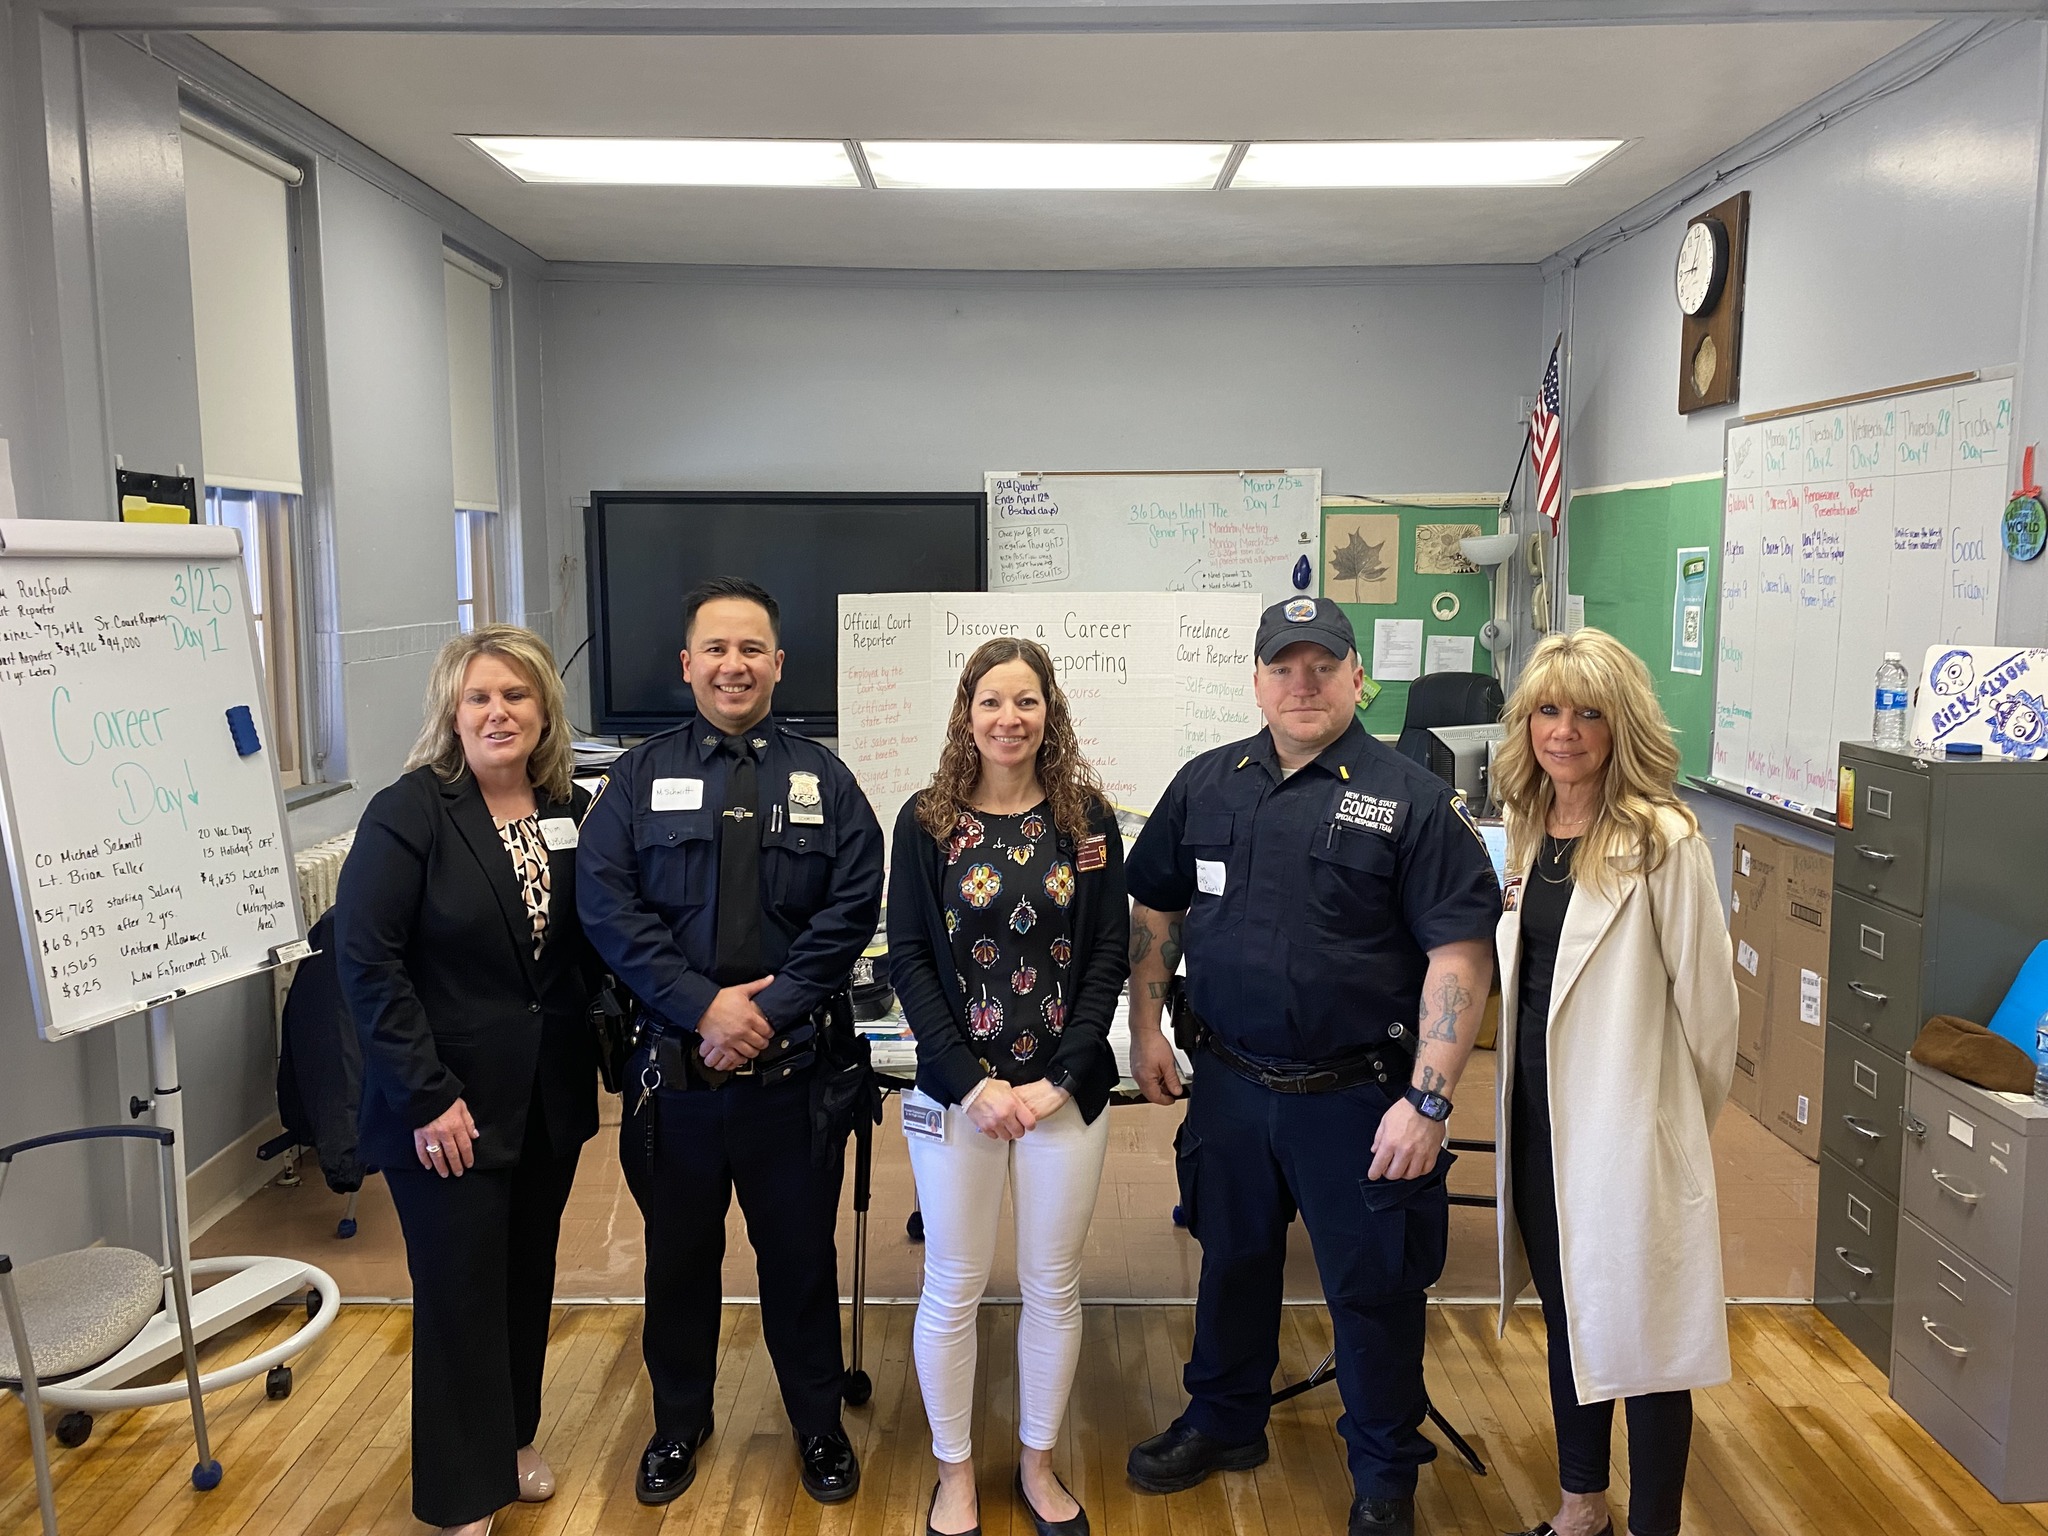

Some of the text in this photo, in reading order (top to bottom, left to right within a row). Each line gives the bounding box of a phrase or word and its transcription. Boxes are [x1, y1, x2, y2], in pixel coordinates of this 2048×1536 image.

[1957, 399, 1996, 447] Friday
[1788, 426, 1801, 450] 25
[1243, 479, 1275, 493] March
[1849, 482, 1873, 502] Project
[1017, 494, 1035, 505] April
[1243, 496, 1267, 516] Day
[1130, 502, 1228, 525] 36 Days Until The
[2007, 521, 2040, 533] WORLD
[1952, 525, 1986, 564] Good
[170, 565, 232, 614] 3/25
[18, 604, 55, 618] Reporter
[843, 612, 911, 630] Official Court
[114, 615, 139, 629] Court
[946, 611, 1132, 639] Discover a Career
[1179, 614, 1230, 639] Freelance
[207, 617, 228, 652] 1
[853, 633, 896, 651] Reporter
[948, 650, 966, 669] In
[1176, 644, 1249, 667] Court Reporter
[848, 666, 903, 681] Employed by the
[857, 682, 896, 695] Court System
[1185, 676, 1245, 700] Self-employed
[851, 698, 912, 715] Certification by
[1185, 700, 1250, 724] Flexible Schedule
[52, 686, 170, 765] Career
[861, 714, 901, 728] state test
[853, 736, 868, 750] Set
[901, 733, 918, 745] hours
[1183, 723, 1221, 744] Travel to
[859, 750, 899, 762] and benefits
[895, 766, 902, 778] to
[1344, 790, 1398, 809] NEW YORK STATE
[1339, 798, 1395, 824] COURTS
[198, 829, 211, 839] 20
[232, 825, 252, 841] Days
[1334, 812, 1393, 834] SPECIAL RESPONSE TEAM
[61, 845, 100, 863] Michael
[220, 841, 253, 856] Holidays
[69, 869, 103, 885] Brian
[113, 862, 145, 876] Fuller
[243, 865, 280, 880] Location
[248, 883, 266, 899] Pay
[35, 884, 182, 925] $54,768 starting Salary
[43, 925, 105, 955] $68,593
[117, 918, 140, 932] after
[147, 912, 156, 924] 2
[165, 931, 208, 951] Allowance
[62, 979, 102, 998] $825
[157, 957, 207, 979] Enforcement
